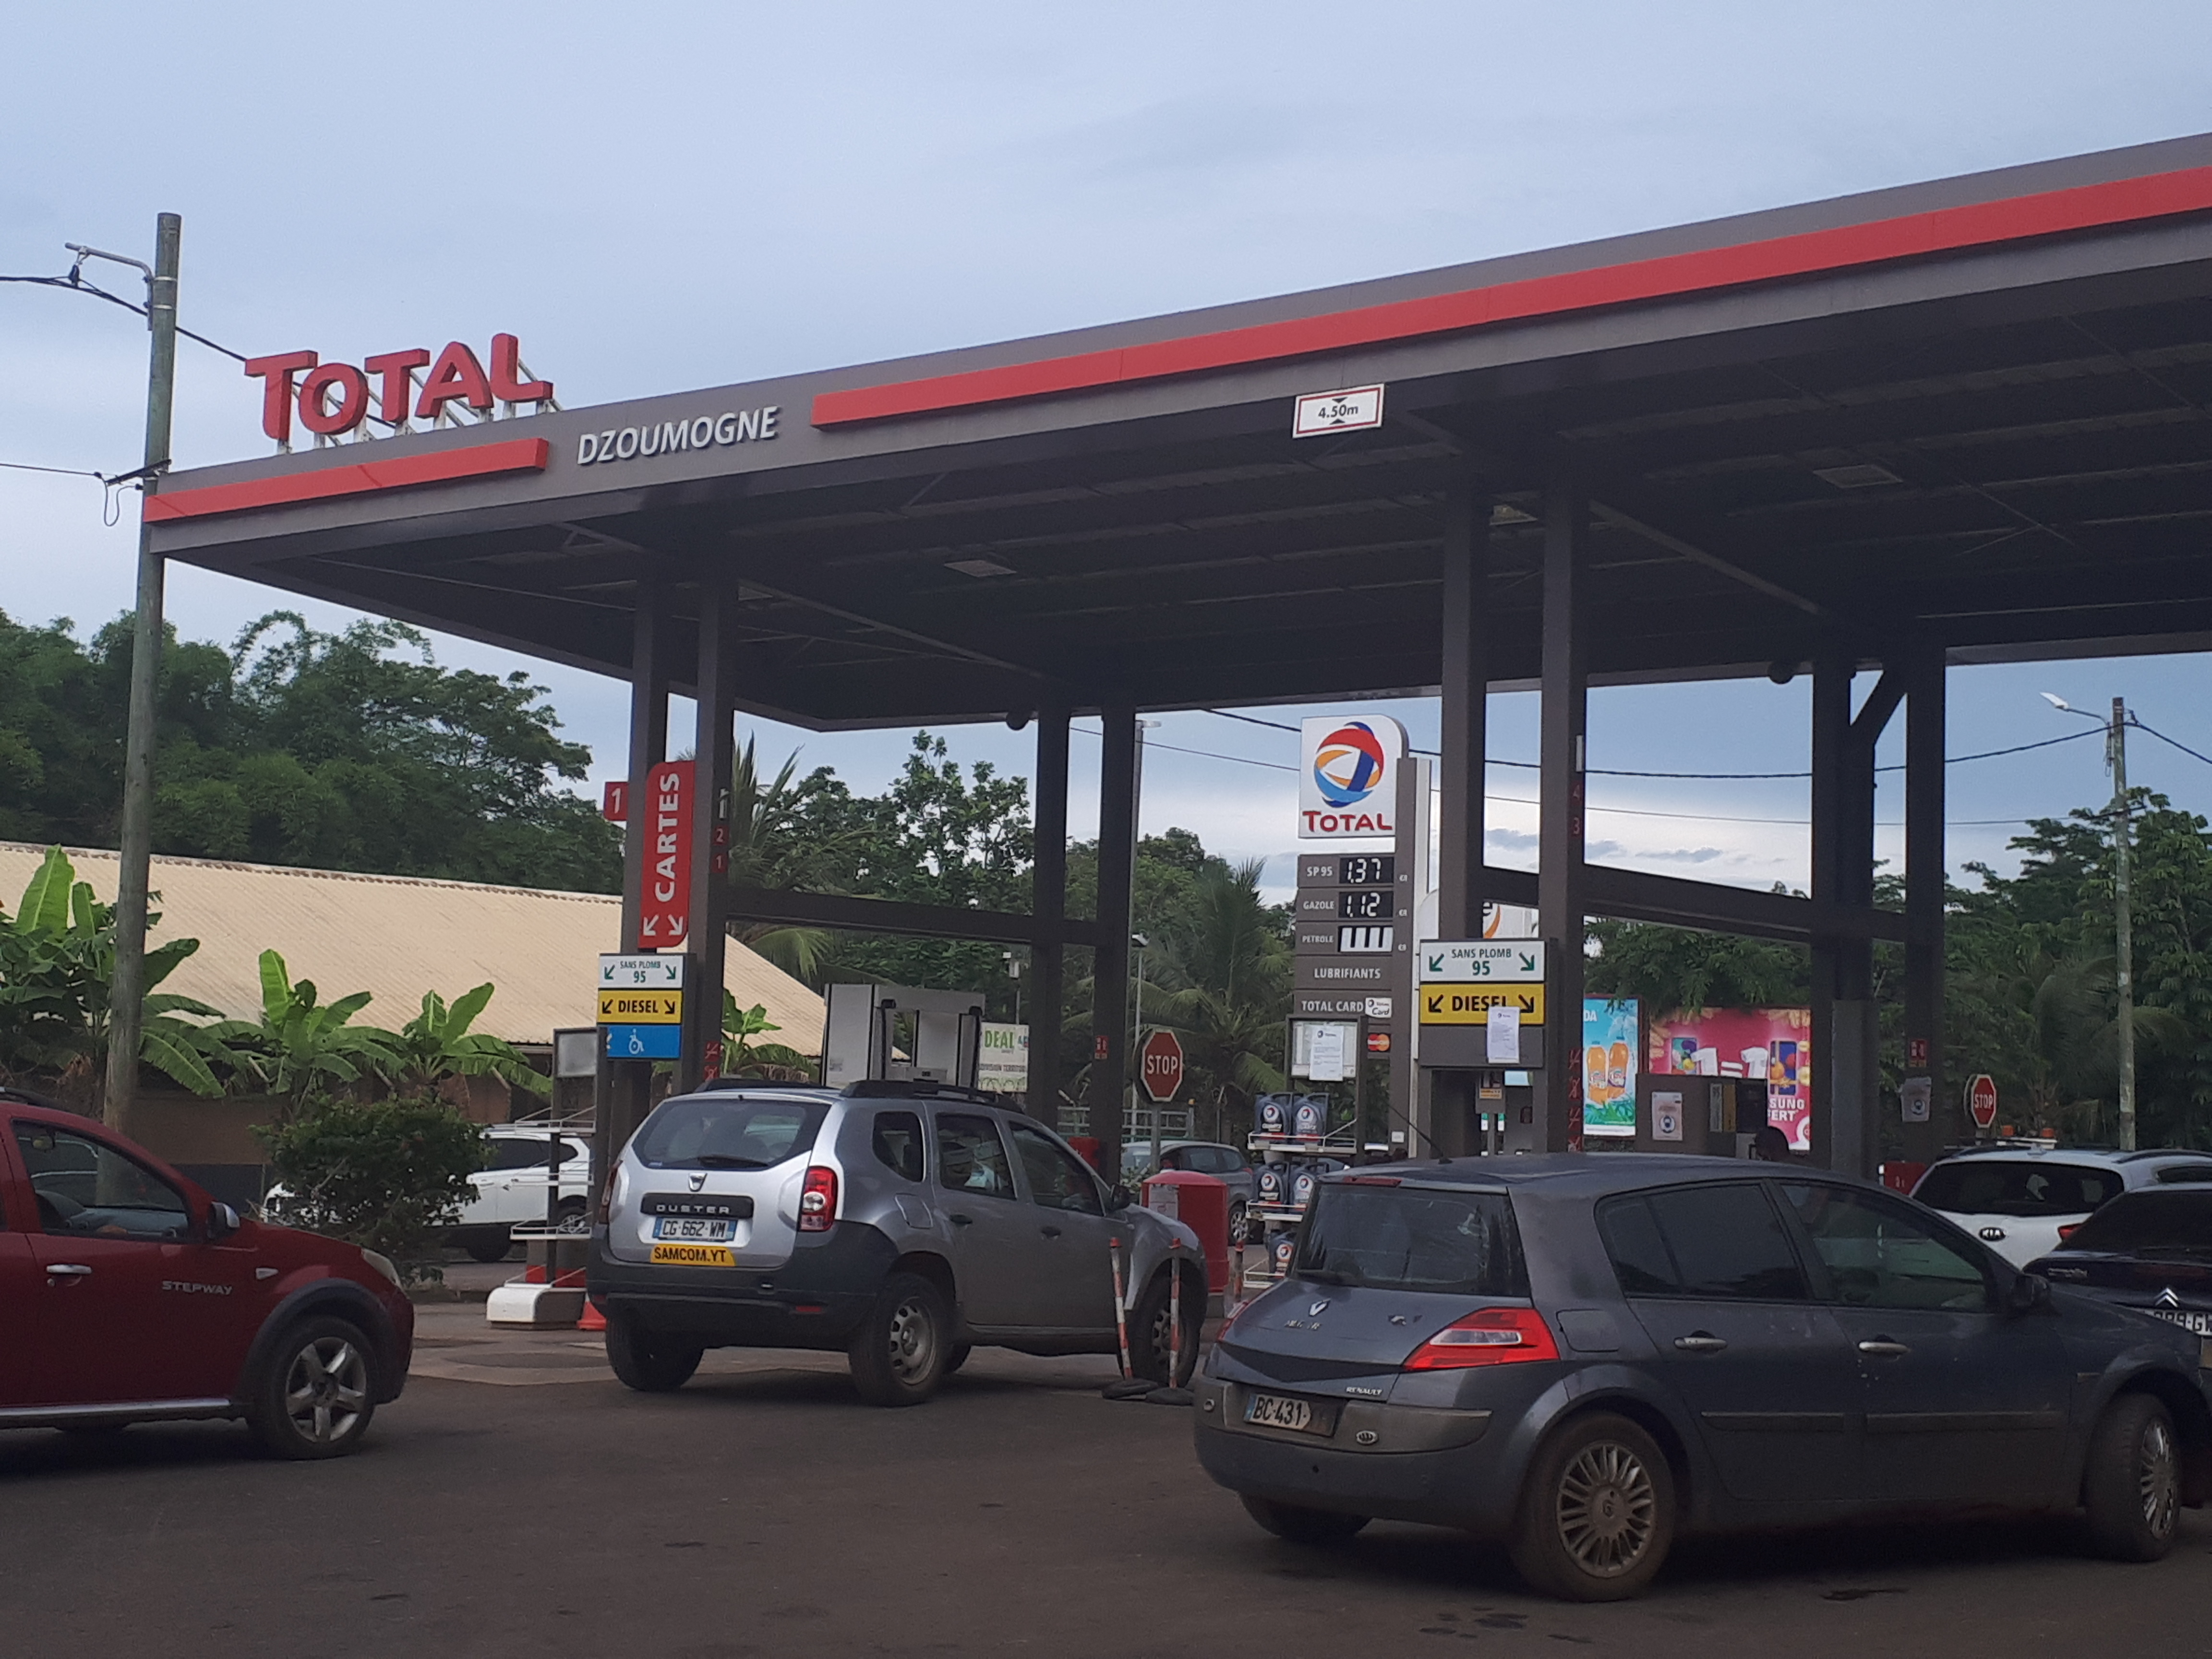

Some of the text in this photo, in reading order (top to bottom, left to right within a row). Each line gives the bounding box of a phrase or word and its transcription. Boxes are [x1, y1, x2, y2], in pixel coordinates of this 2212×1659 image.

[244, 333, 553, 440] TOTAL
[1318, 404, 1358, 419] 4.50m
[577, 406, 780, 466] DZOUMOGNE
[611, 788, 621, 814] 1
[1302, 810, 1393, 832] TOTAL
[1573, 817, 1580, 834] 3
[655, 772, 680, 902] CARTES
[716, 829, 723, 842] 2
[716, 855, 721, 869] 1
[1347, 858, 1381, 883] 1.37
[1303, 901, 1334, 910] GAZOLE
[1451, 949, 1512, 958] SANS PLOMB
[1314, 968, 1381, 979] LUBRIFIANTS
[1472, 960, 1491, 975] 95
[633, 971, 646, 983] 95
[618, 1000, 659, 1013] DIESEL
[1301, 1000, 1364, 1012] TOTAL CARD
[985, 1030, 1014, 1048] DEAL
[1147, 1055, 1178, 1075] STOP
[1974, 1094, 1994, 1109] STOP
[656, 1204, 730, 1214] DUSTER
[1983, 1229, 2001, 1238] KIA
[654, 1247, 727, 1262] SAMCOM.YT
[162, 1281, 232, 1295] STEPWAY
[1346, 1387, 1382, 1395] RENAULT
